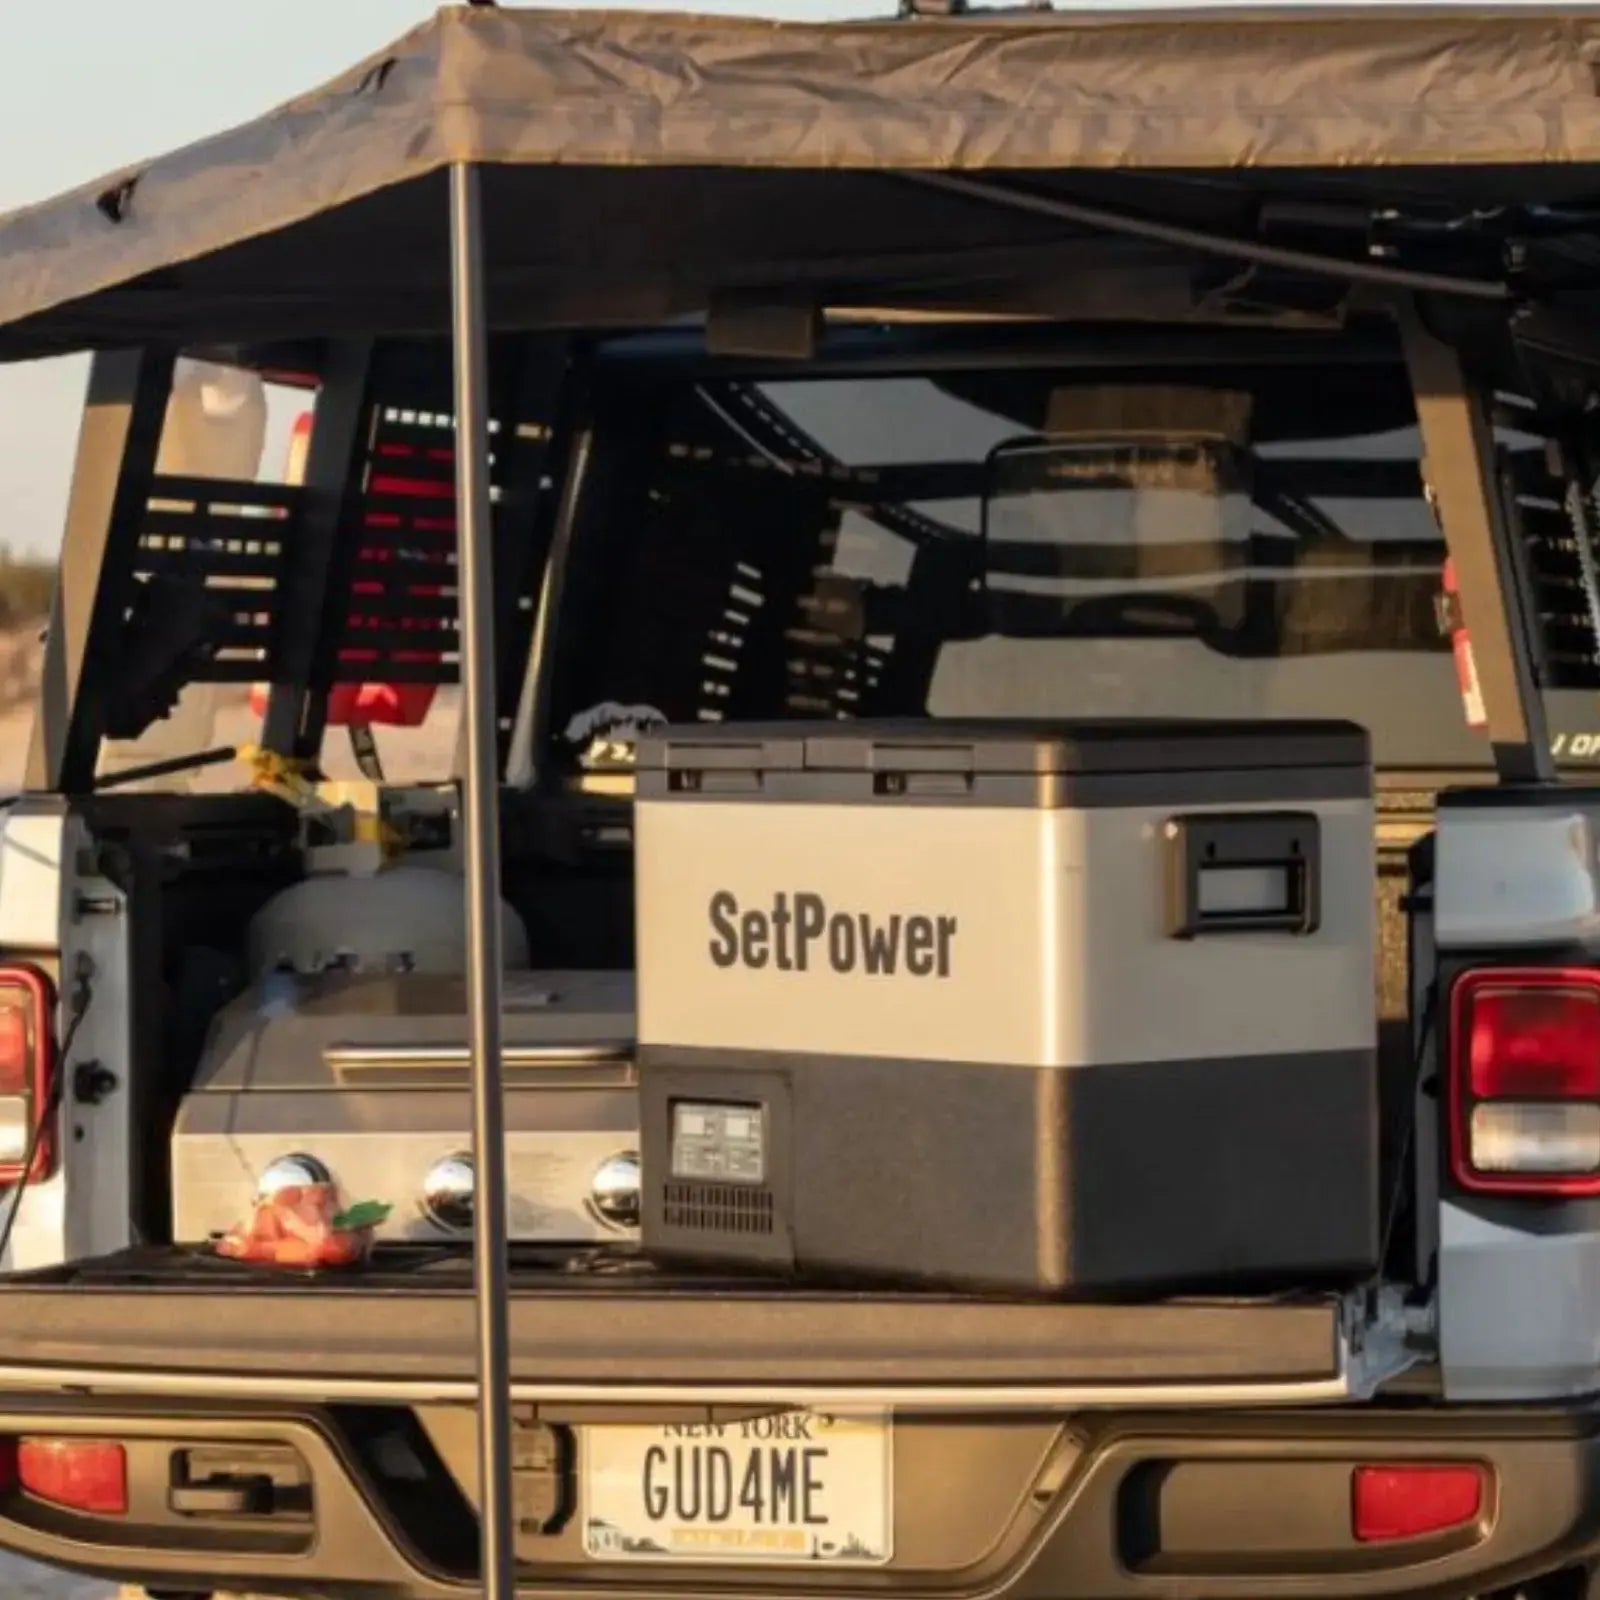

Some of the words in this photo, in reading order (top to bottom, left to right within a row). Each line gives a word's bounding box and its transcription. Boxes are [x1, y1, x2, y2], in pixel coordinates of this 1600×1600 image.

[708, 890, 957, 978] SetPower
[740, 1415, 812, 1439] YORK
[643, 1444, 829, 1525] GUD4ME
